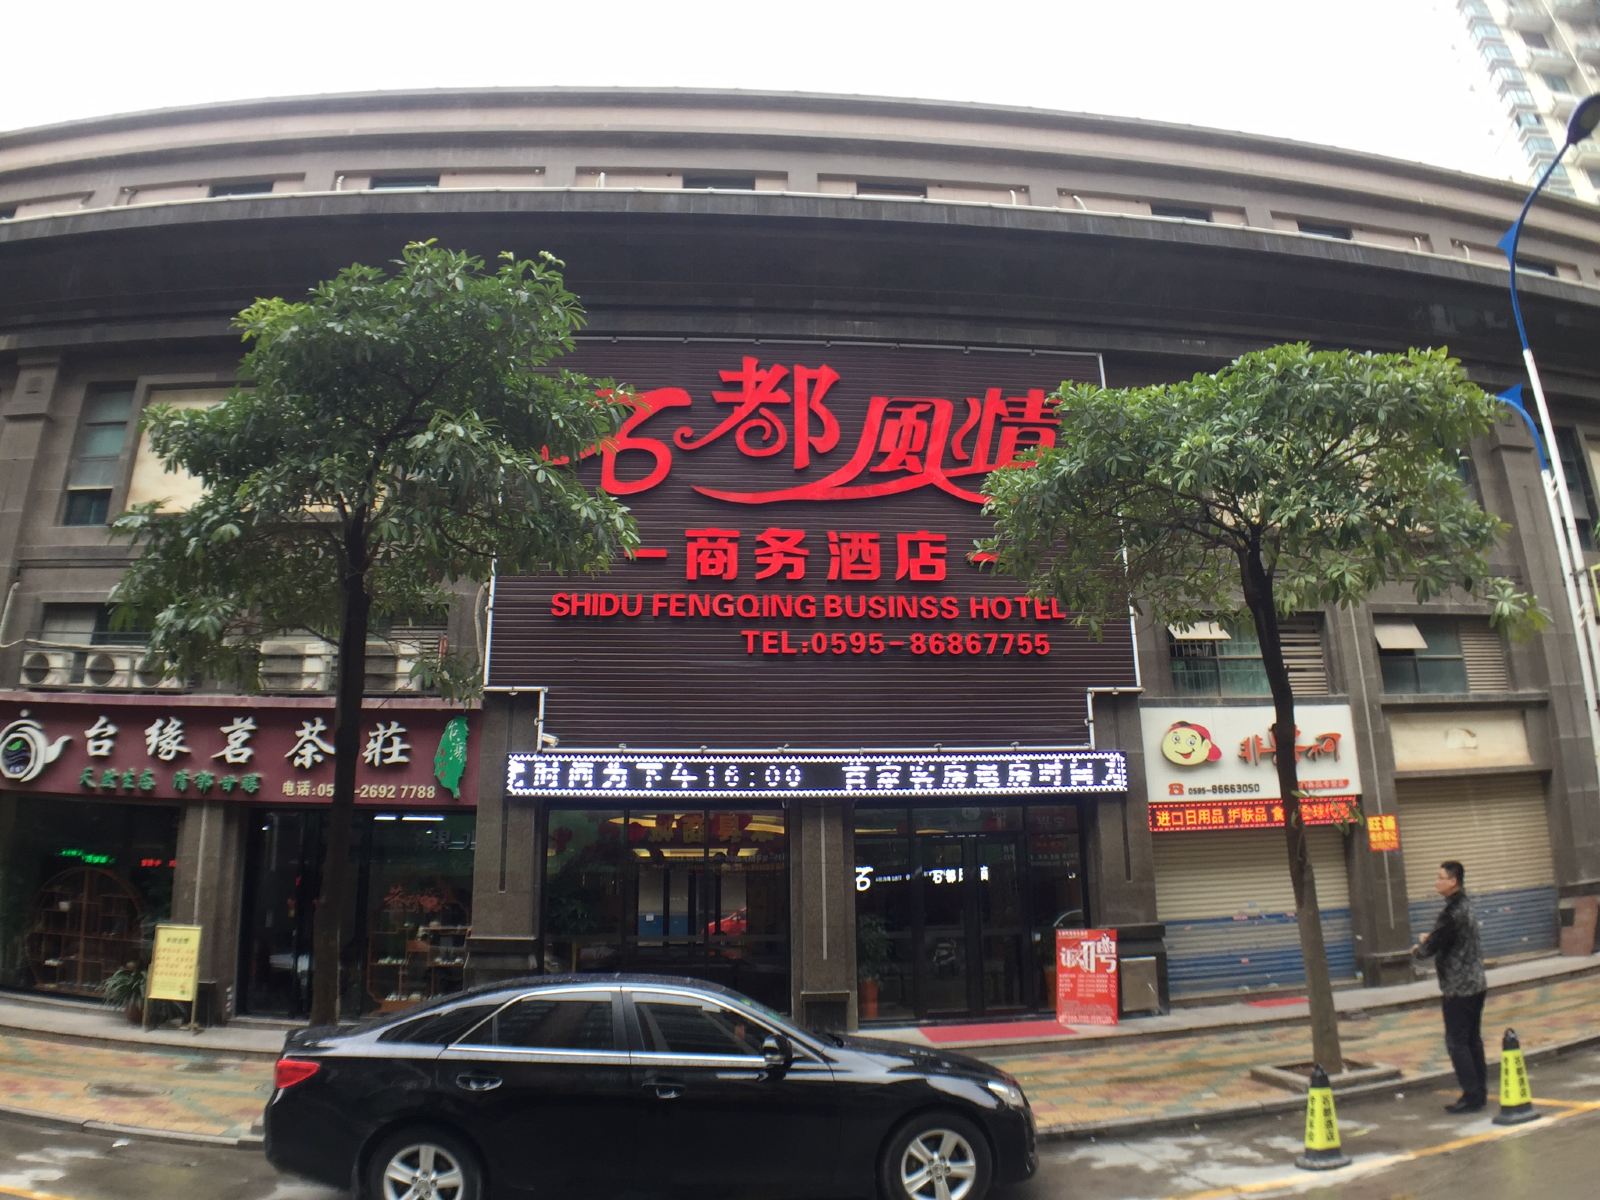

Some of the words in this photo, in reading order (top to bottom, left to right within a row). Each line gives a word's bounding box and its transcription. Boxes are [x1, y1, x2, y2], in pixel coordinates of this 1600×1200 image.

[685, 527, 948, 582] 商务酒店
[551, 592, 644, 619] SHIDU
[652, 593, 817, 619] FENGQING
[824, 594, 960, 620] BUSINSS
[969, 596, 1066, 620] HOTEL
[401, 785, 436, 799] 7788
[1156, 808, 1224, 827] 进口日用品
[1227, 806, 1268, 825] 护肤品
[1271, 805, 1285, 822] 食
